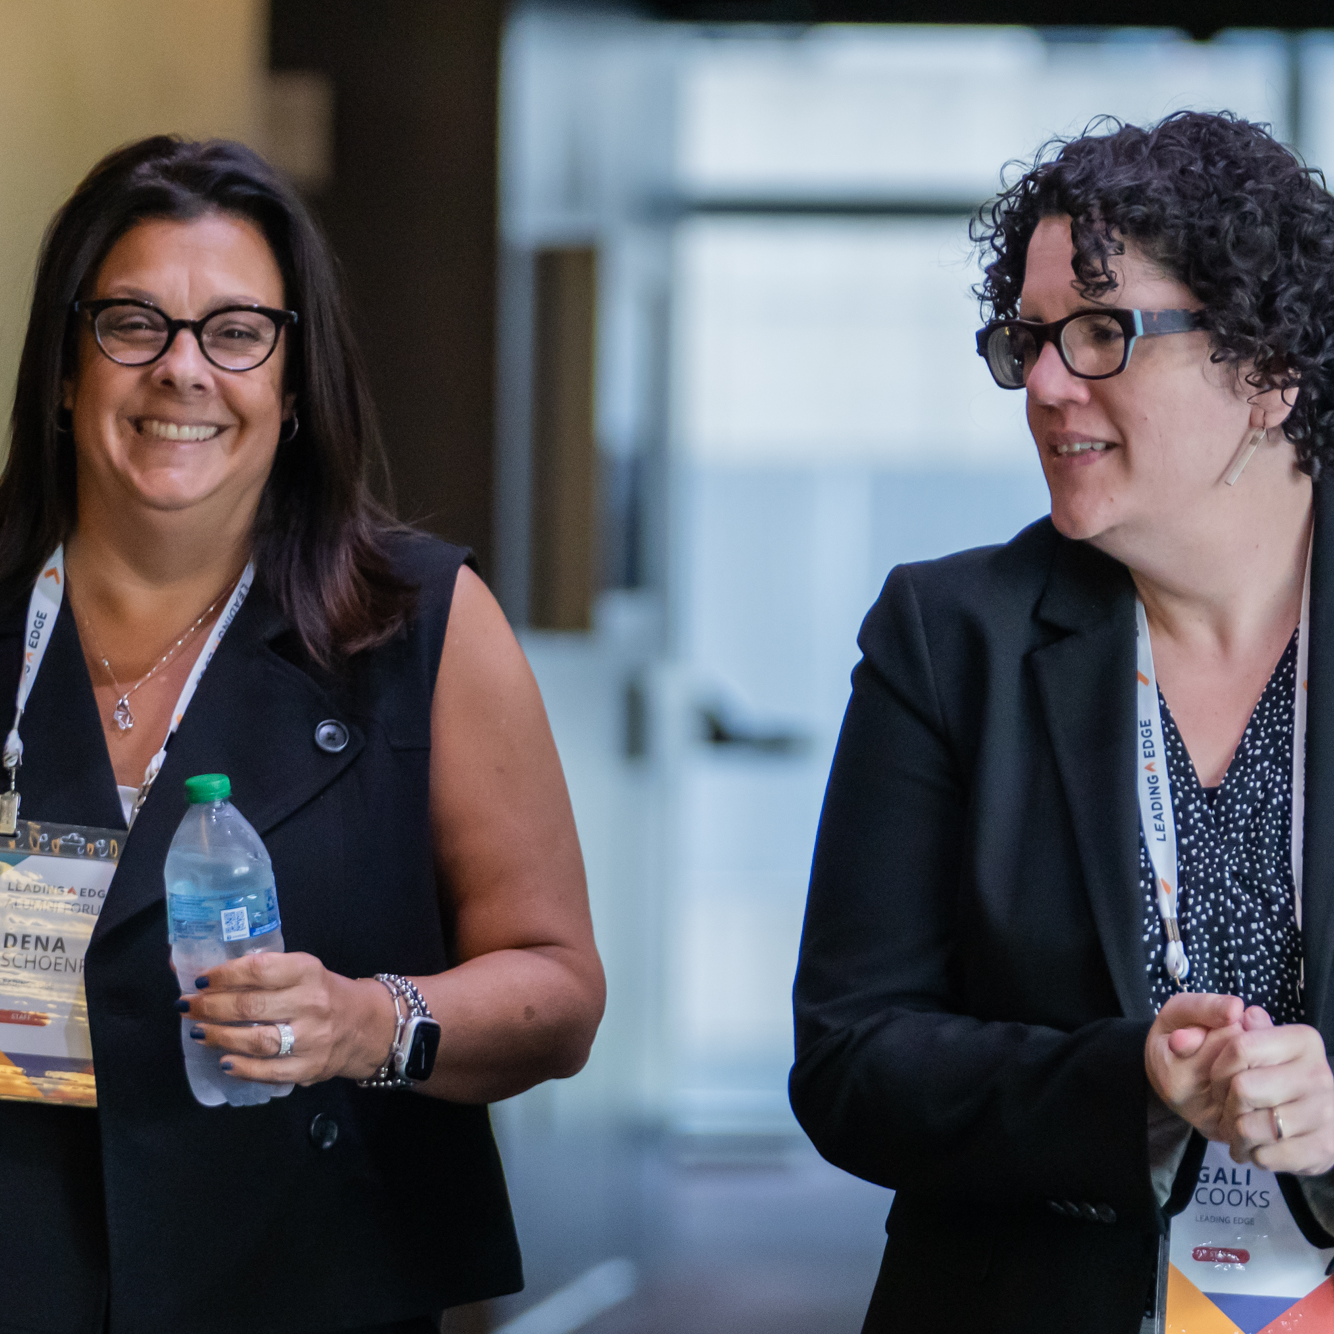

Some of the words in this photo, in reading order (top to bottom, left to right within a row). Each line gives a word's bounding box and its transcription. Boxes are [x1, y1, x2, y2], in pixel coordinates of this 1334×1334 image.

[28, 610, 48, 649] EDGE
[1139, 718, 1156, 759] EDGE
[1147, 774, 1167, 842] LEADING
[7, 881, 66, 896] LEADING
[3, 932, 66, 953] DENA
[1198, 1166, 1252, 1186] GALI
[1194, 1186, 1271, 1209] COOKS
[1195, 1214, 1231, 1225] LEADING
[1233, 1216, 1256, 1226] EDGE
